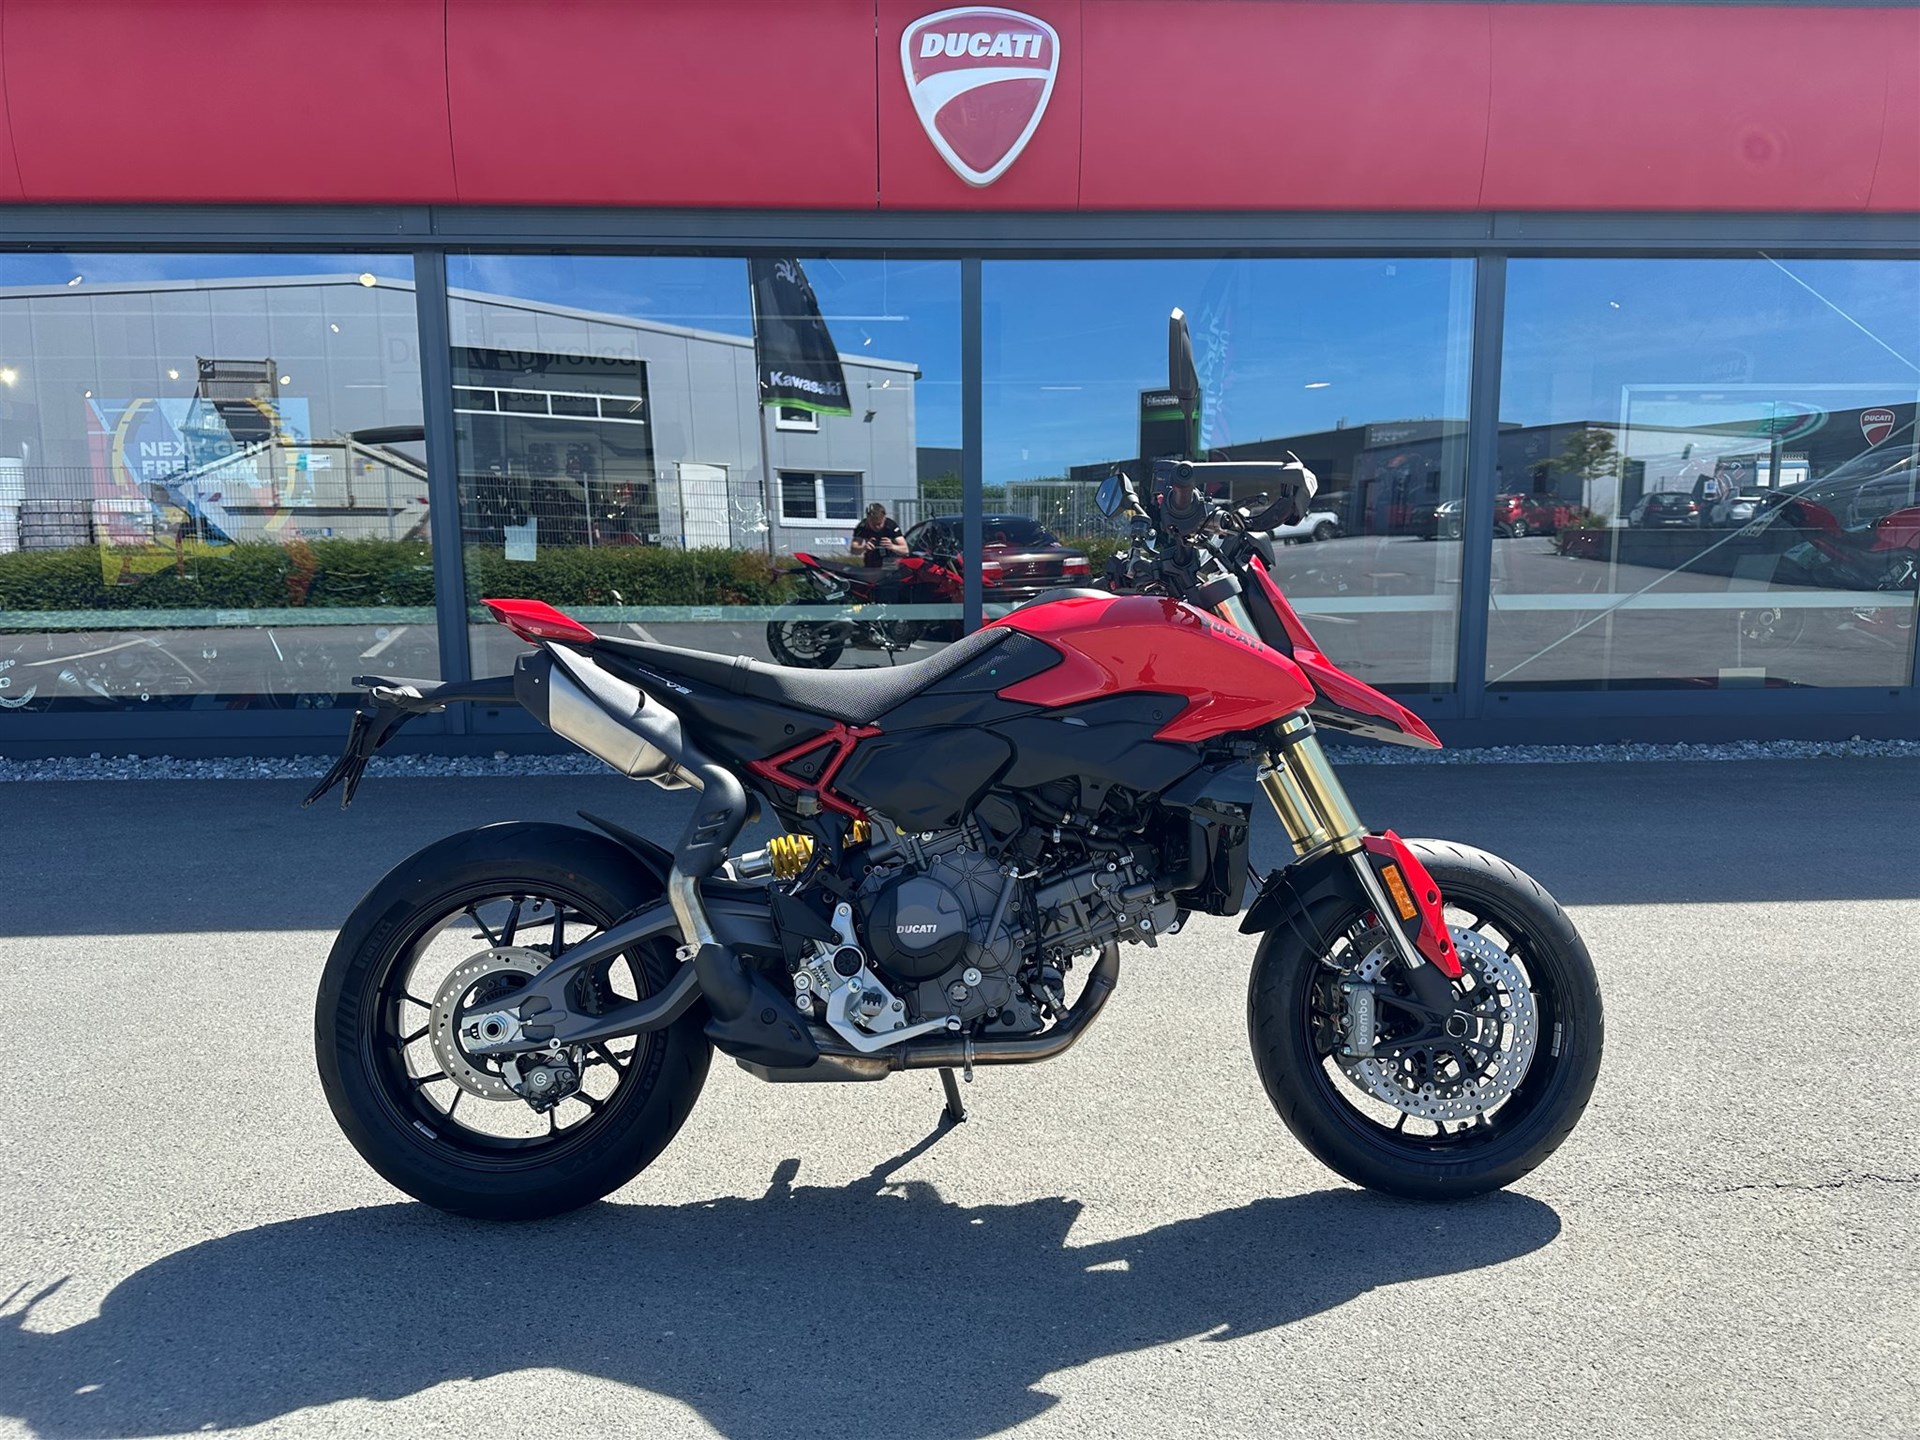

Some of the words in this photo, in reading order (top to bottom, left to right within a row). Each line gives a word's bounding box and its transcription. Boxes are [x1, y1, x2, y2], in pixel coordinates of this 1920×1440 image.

[920, 32, 1043, 59] DUCATI
[770, 371, 841, 396] Kawasaki
[1864, 414, 1892, 422] DUCATI
[140, 441, 263, 456] NEXT-GEN
[1200, 615, 1264, 652] DUCATI
[896, 924, 937, 934] DUCATI
[1358, 998, 1368, 1045] brembo
